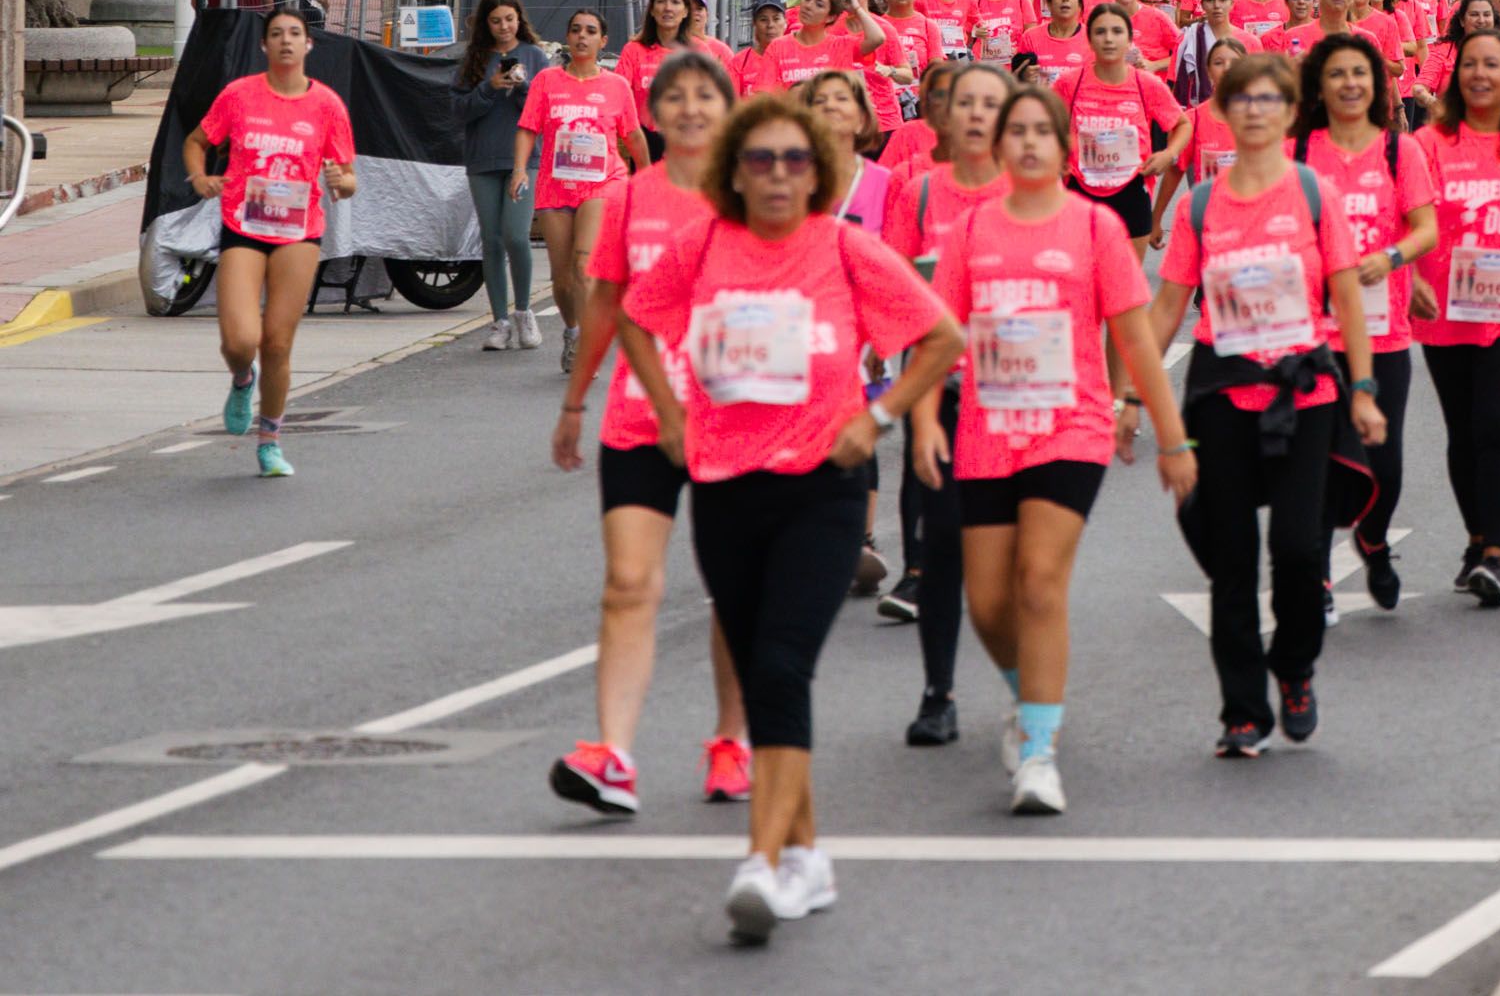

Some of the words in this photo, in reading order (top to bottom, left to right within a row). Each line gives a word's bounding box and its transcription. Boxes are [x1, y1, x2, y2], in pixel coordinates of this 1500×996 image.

[551, 105, 598, 120] CARRERA
[244, 132, 304, 157] CARRERA
[1098, 152, 1120, 163] 016
